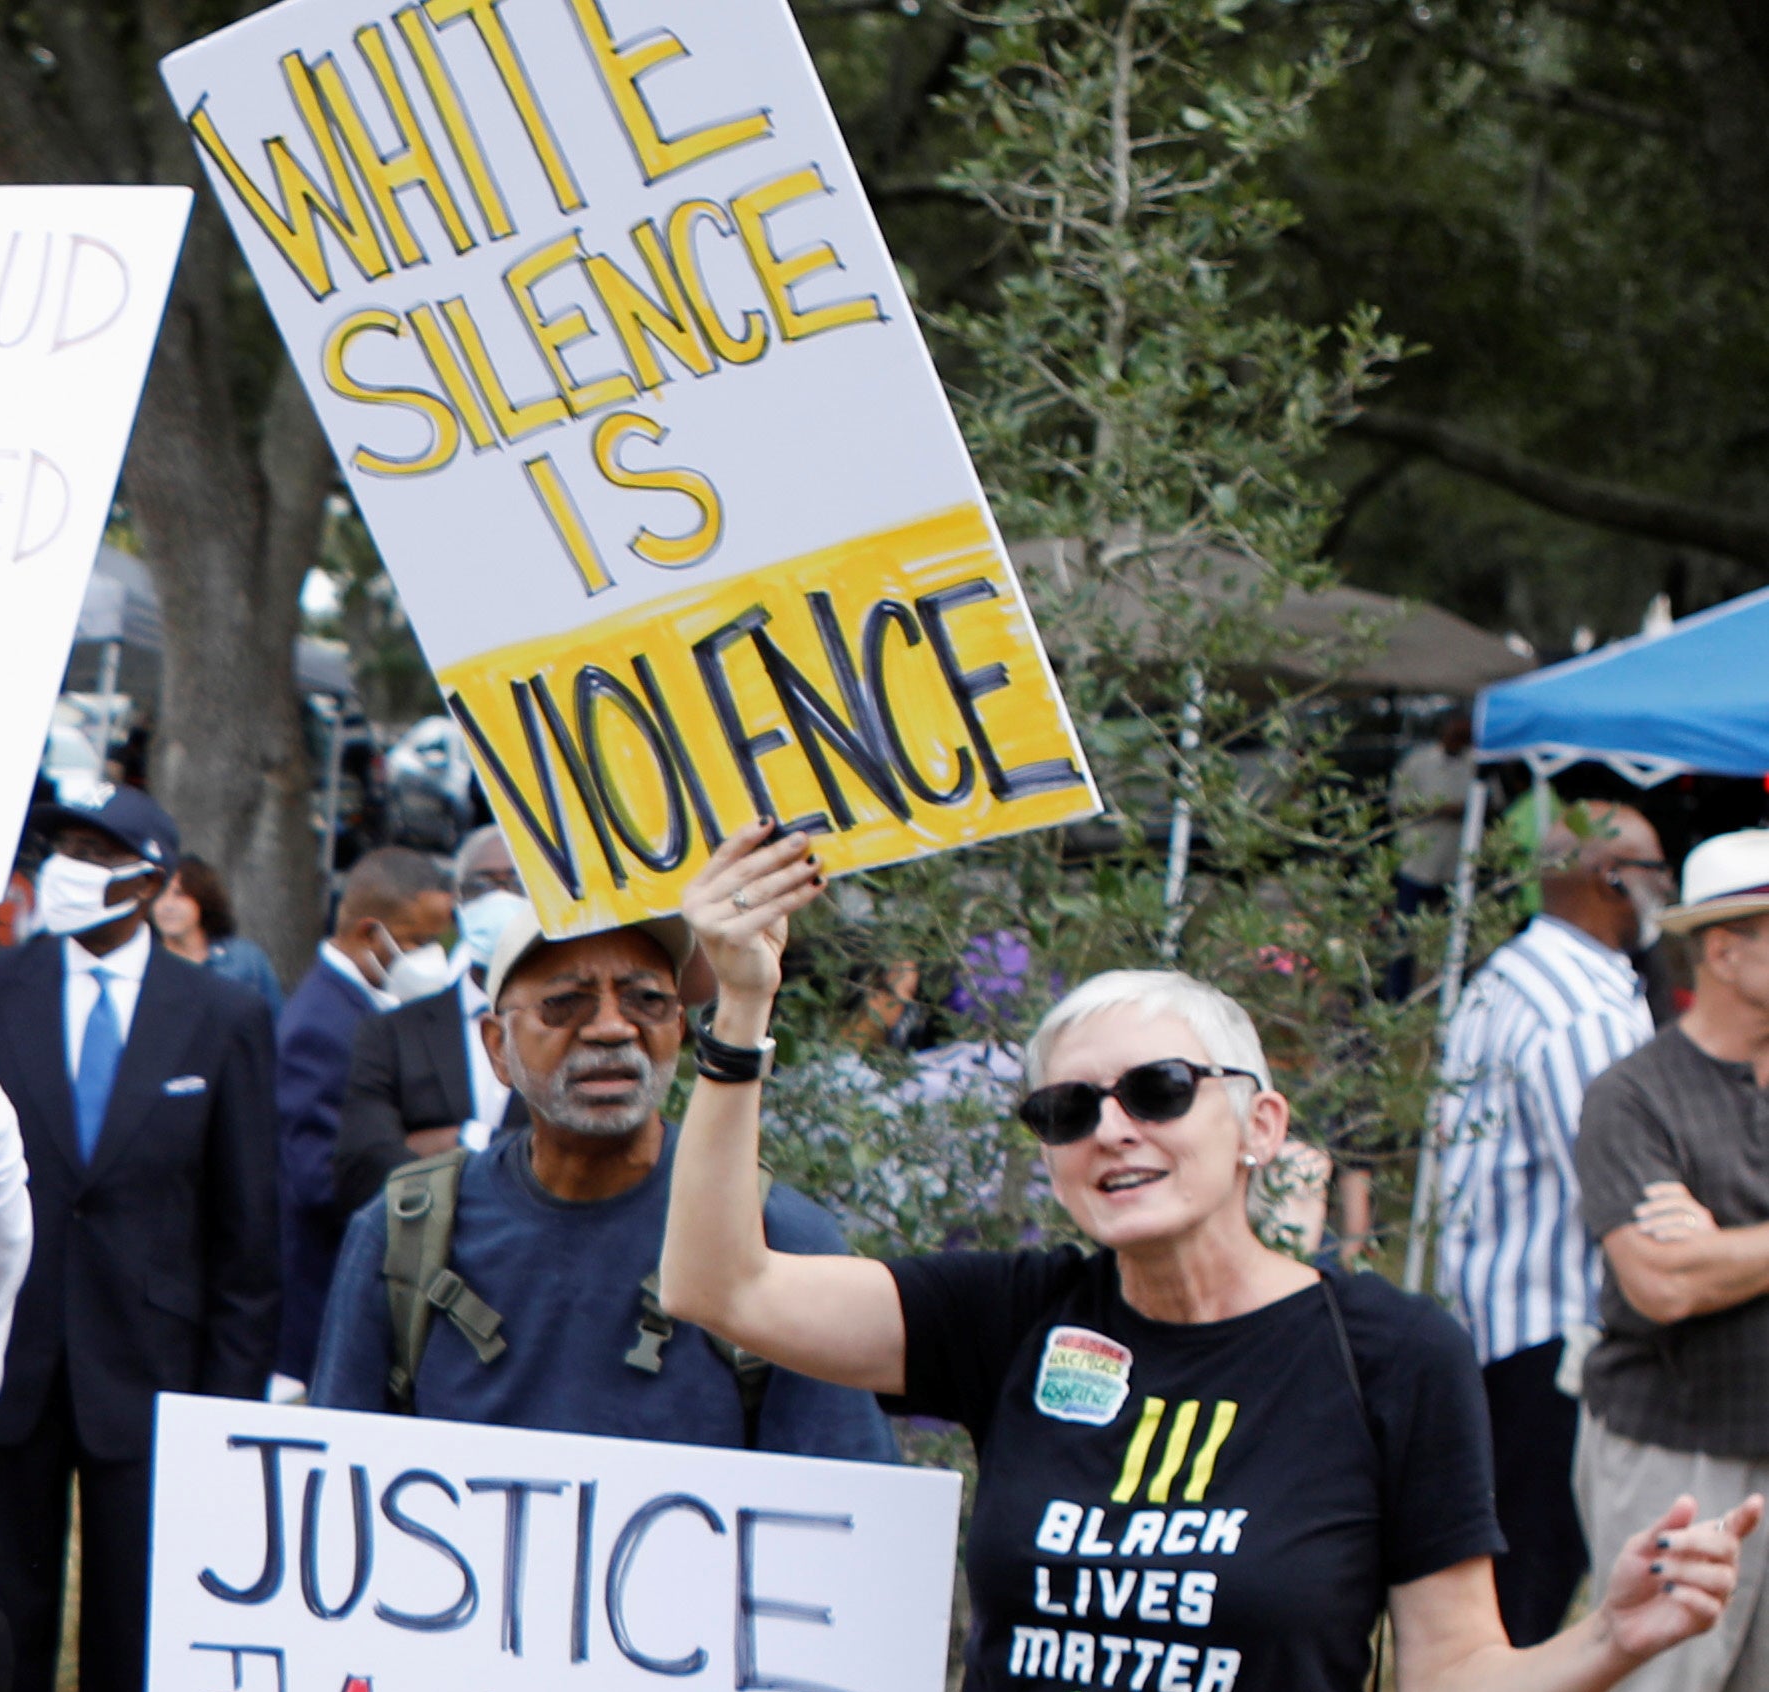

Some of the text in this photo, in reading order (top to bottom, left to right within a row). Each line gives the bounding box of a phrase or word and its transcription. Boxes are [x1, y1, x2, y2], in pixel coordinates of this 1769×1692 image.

[188, 0, 775, 303] WHITE
[320, 162, 893, 478] SILENCE
[522, 410, 726, 598] IS
[448, 576, 1085, 901] VIOLENCE
[1034, 1565, 1218, 1627] LIVES
[1035, 1499, 1249, 1557] BLACK
